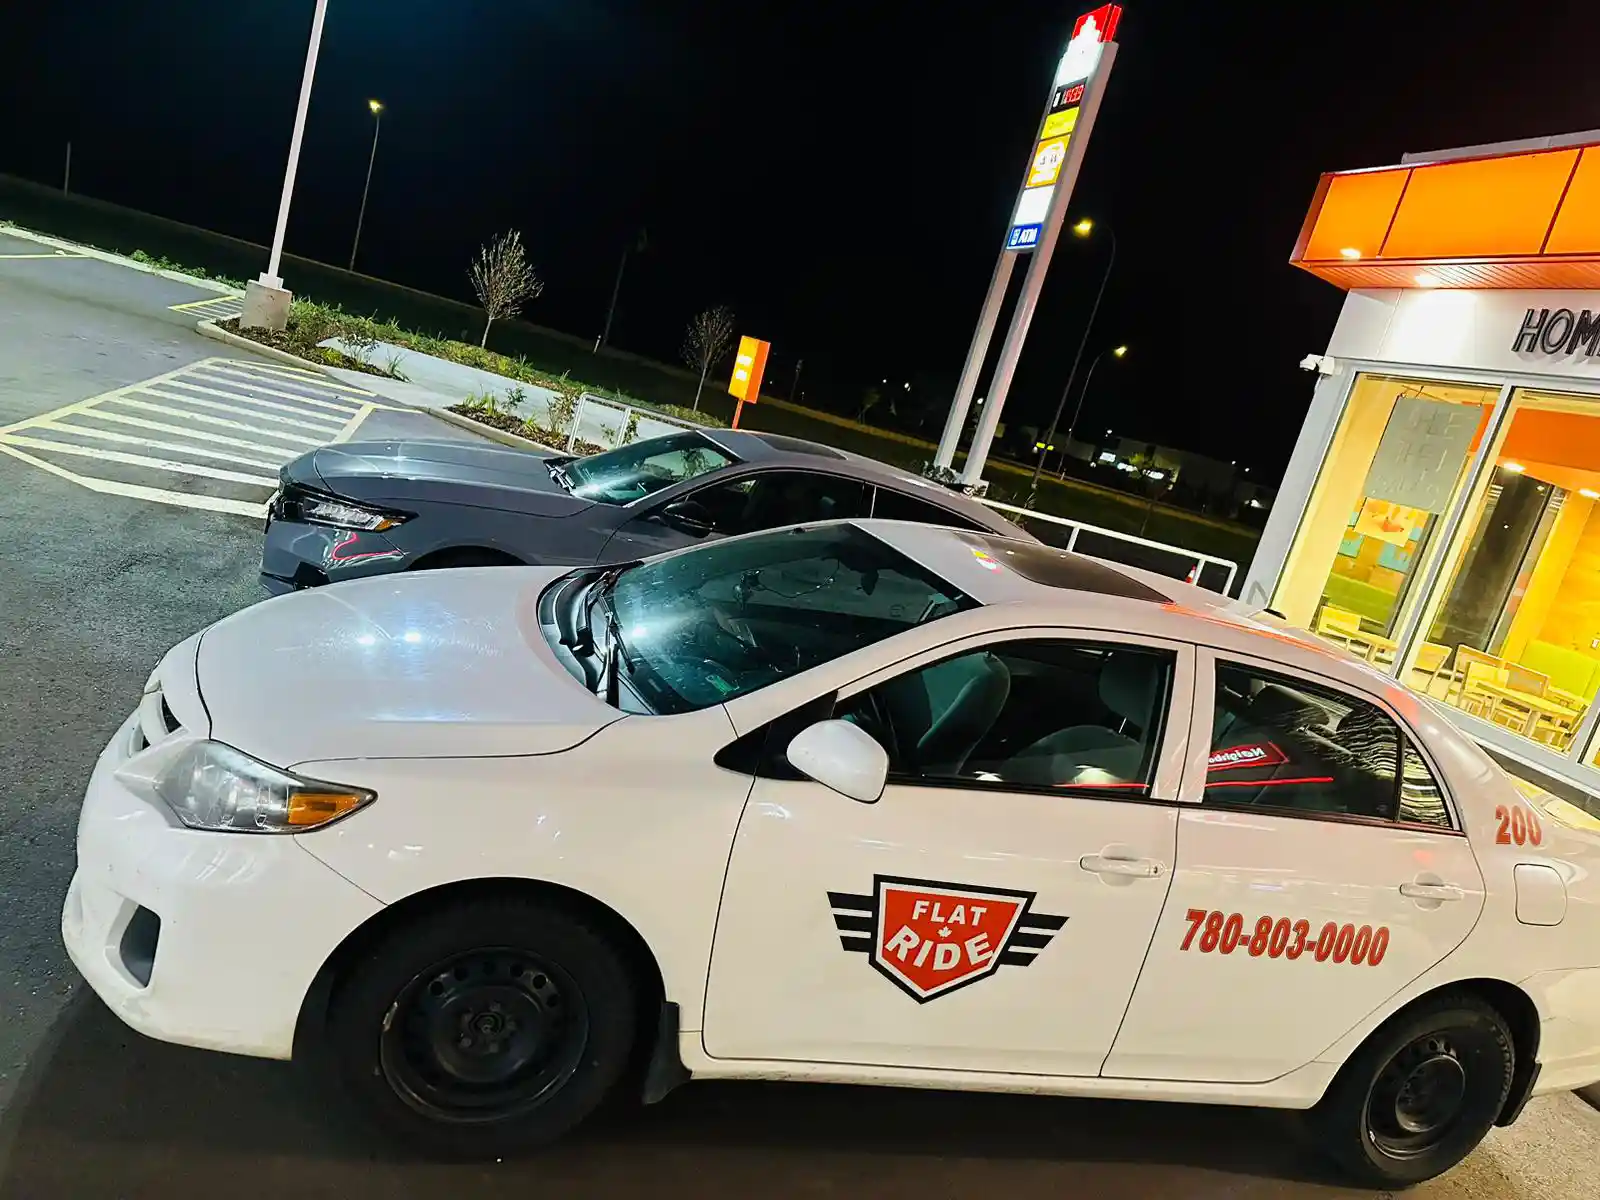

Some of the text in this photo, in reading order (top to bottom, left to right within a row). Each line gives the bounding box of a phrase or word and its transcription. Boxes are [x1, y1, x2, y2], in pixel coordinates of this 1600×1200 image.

[1511, 307, 1600, 357] HOM
[1495, 804, 1542, 847] 200
[911, 900, 988, 927] FLAT
[1179, 908, 1391, 967] 780-803-0000
[883, 924, 996, 972] RIDE
